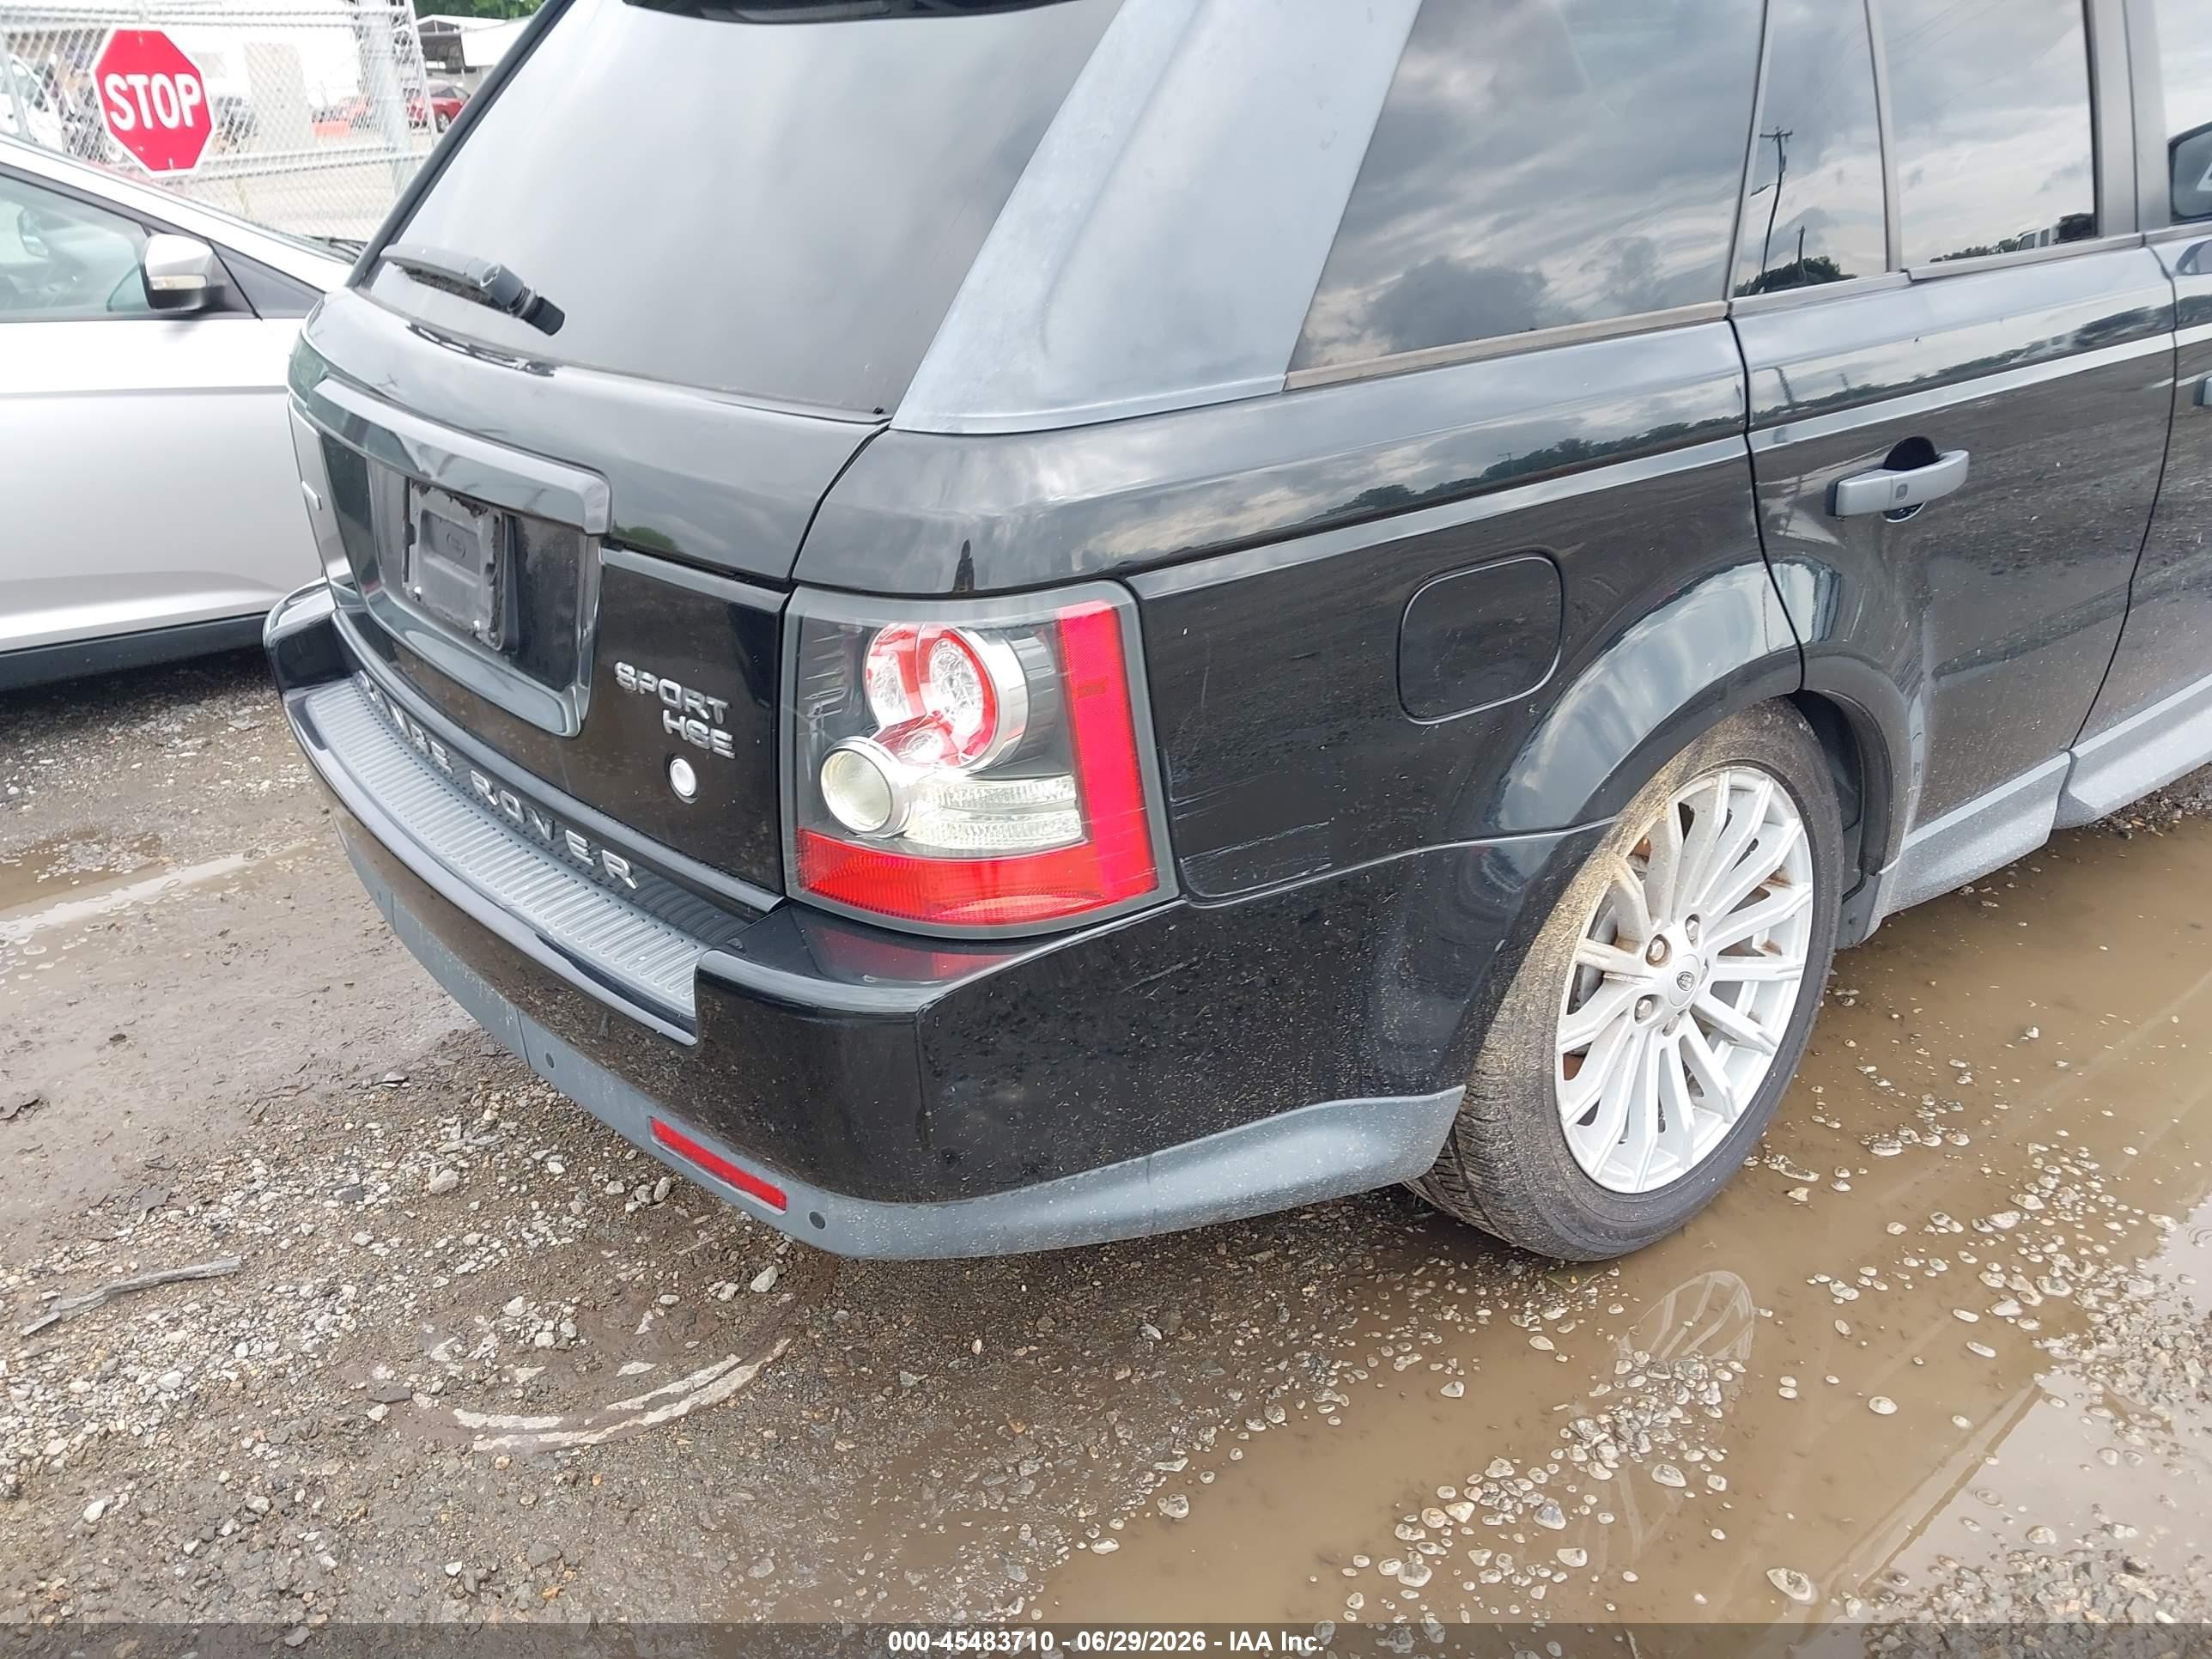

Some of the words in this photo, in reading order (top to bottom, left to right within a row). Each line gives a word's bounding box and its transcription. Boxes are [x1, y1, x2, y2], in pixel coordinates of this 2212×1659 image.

[104, 72, 202, 131] STOP
[614, 661, 729, 725] SPORT
[662, 709, 736, 760] HSE
[470, 769, 639, 890] ROVER
